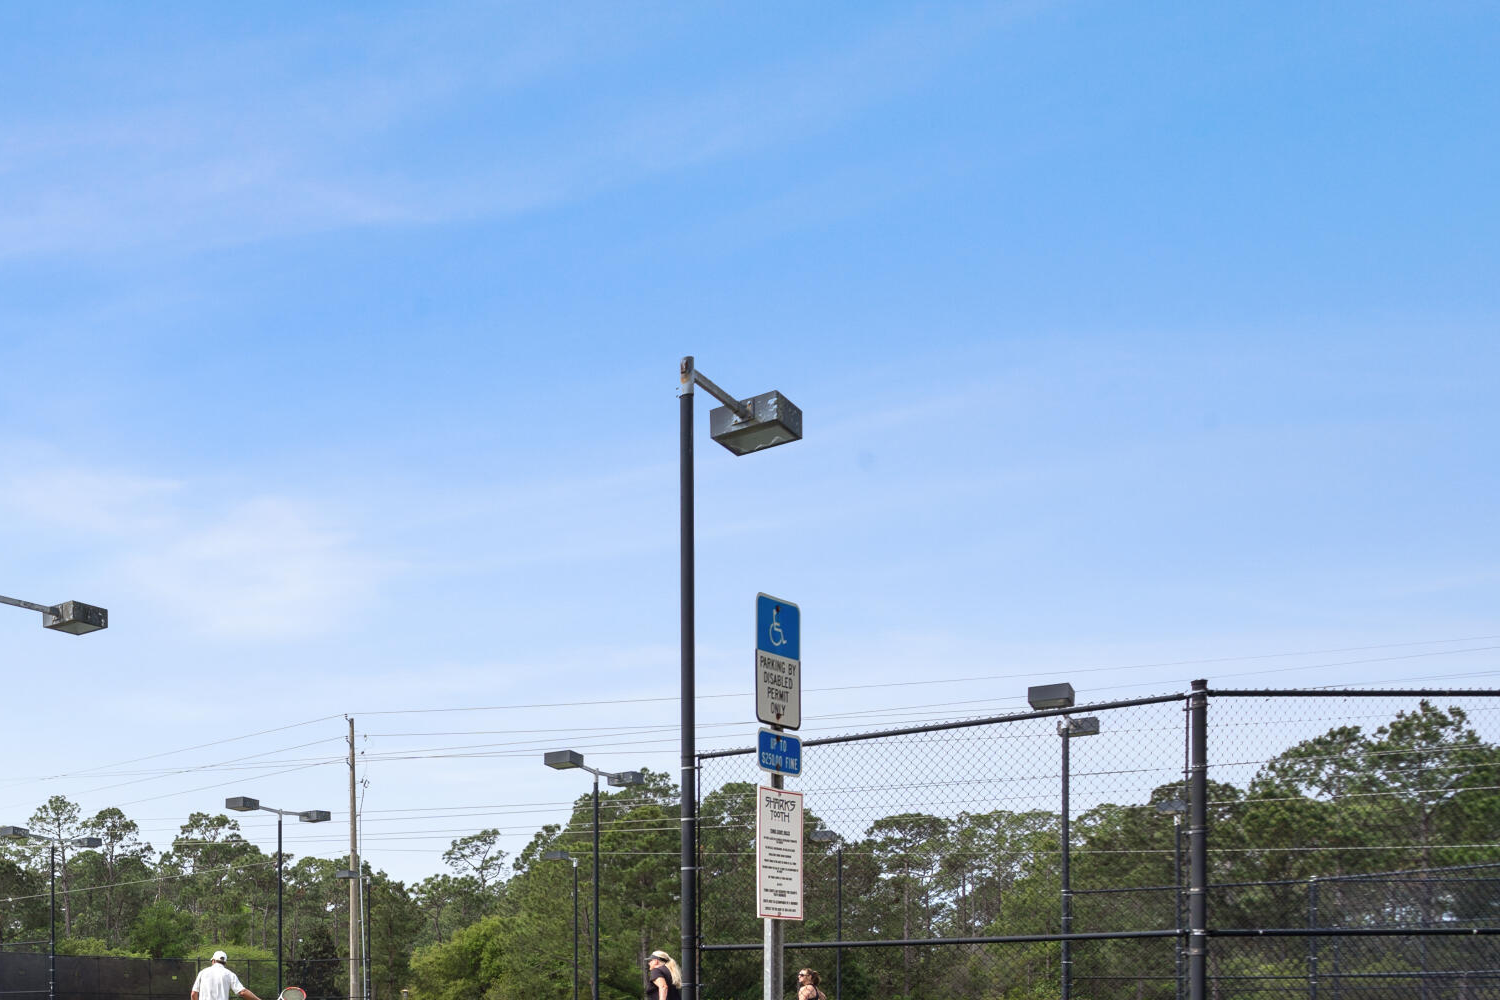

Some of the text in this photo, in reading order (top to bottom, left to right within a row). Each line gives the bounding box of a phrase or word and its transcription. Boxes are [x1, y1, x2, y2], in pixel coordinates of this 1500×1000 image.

[759, 655, 797, 676] PARKING BY
[763, 671, 794, 690] DISABLED
[767, 686, 789, 703] PERMIT
[770, 701, 786, 716] ONLY
